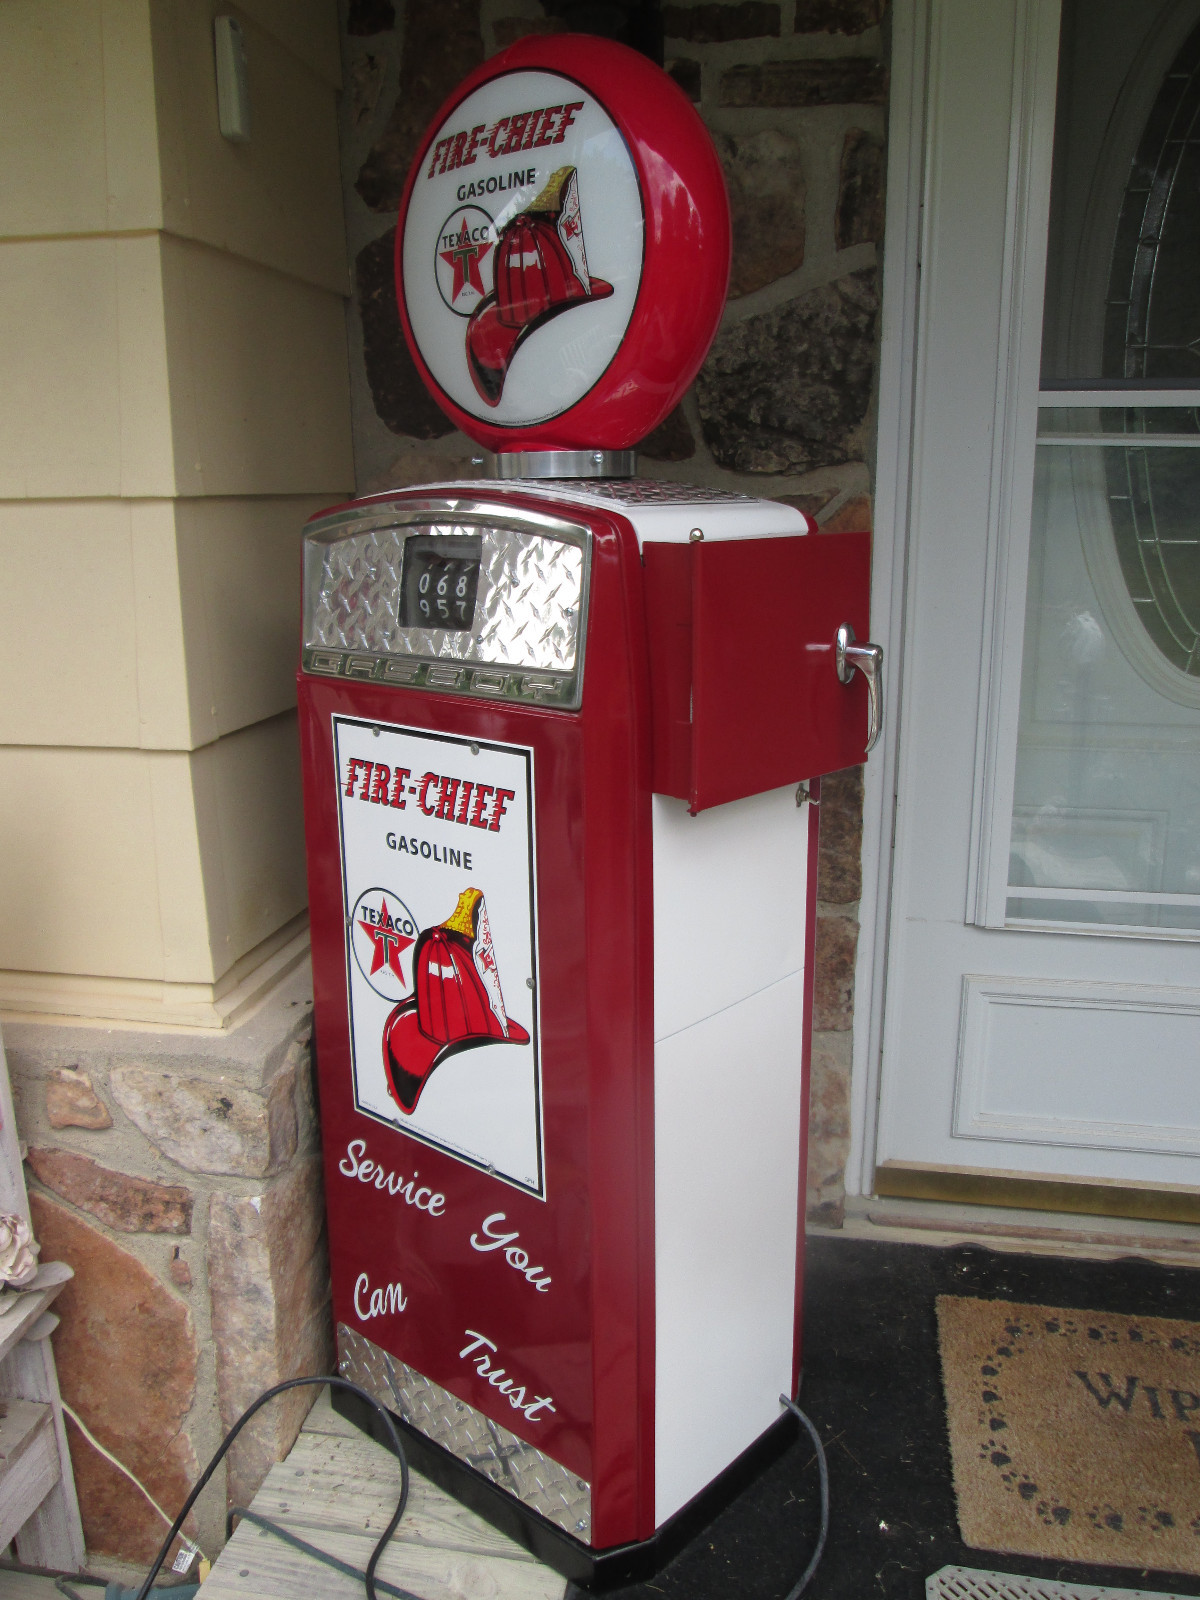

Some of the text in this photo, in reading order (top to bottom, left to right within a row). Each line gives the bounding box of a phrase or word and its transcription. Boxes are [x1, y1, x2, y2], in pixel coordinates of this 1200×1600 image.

[427, 101, 585, 179] FIRE-CHIEF
[457, 168, 536, 201] GASOLINE
[442, 226, 489, 248] TEXACO
[419, 573, 468, 598] 068
[419, 599, 467, 620] 957
[310, 652, 563, 699] GASBOY
[342, 757, 516, 833] FIRE-CHIEF
[386, 832, 473, 871] GASOLINE
[361, 905, 414, 937] TEXACO
[338, 1139, 446, 1217] Service
[469, 1212, 552, 1292] You
[353, 1272, 557, 1422] Can Trust
